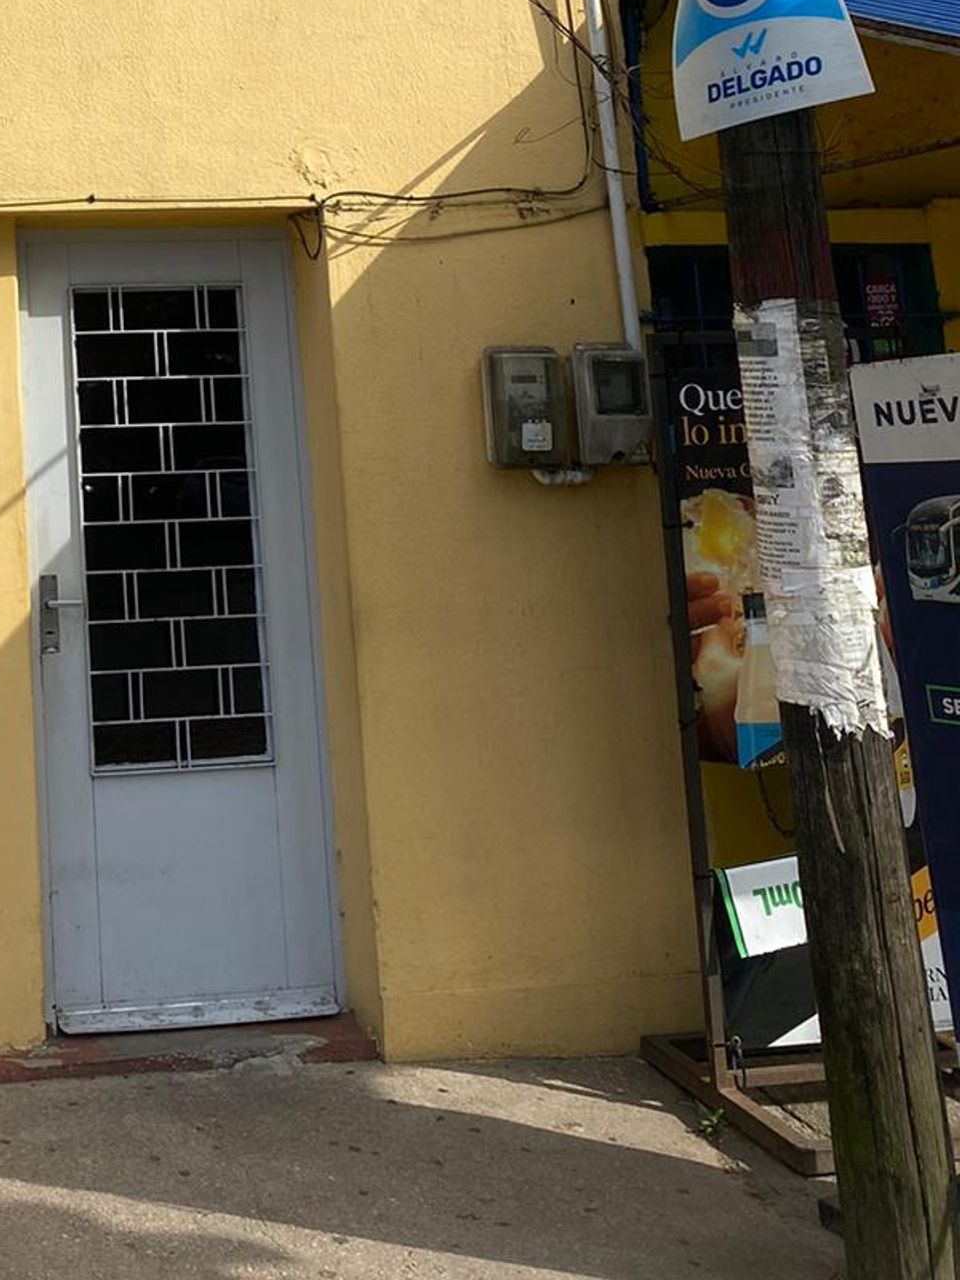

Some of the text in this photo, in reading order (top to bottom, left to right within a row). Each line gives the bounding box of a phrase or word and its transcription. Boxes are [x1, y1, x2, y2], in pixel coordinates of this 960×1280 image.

[707, 55, 823, 104] DELGADO
[729, 85, 806, 110] PRESIDENTE
[679, 383, 743, 416] Que
[873, 396, 959, 427] NUEV
[680, 415, 710, 446] lo
[685, 463, 737, 481] Nueva
